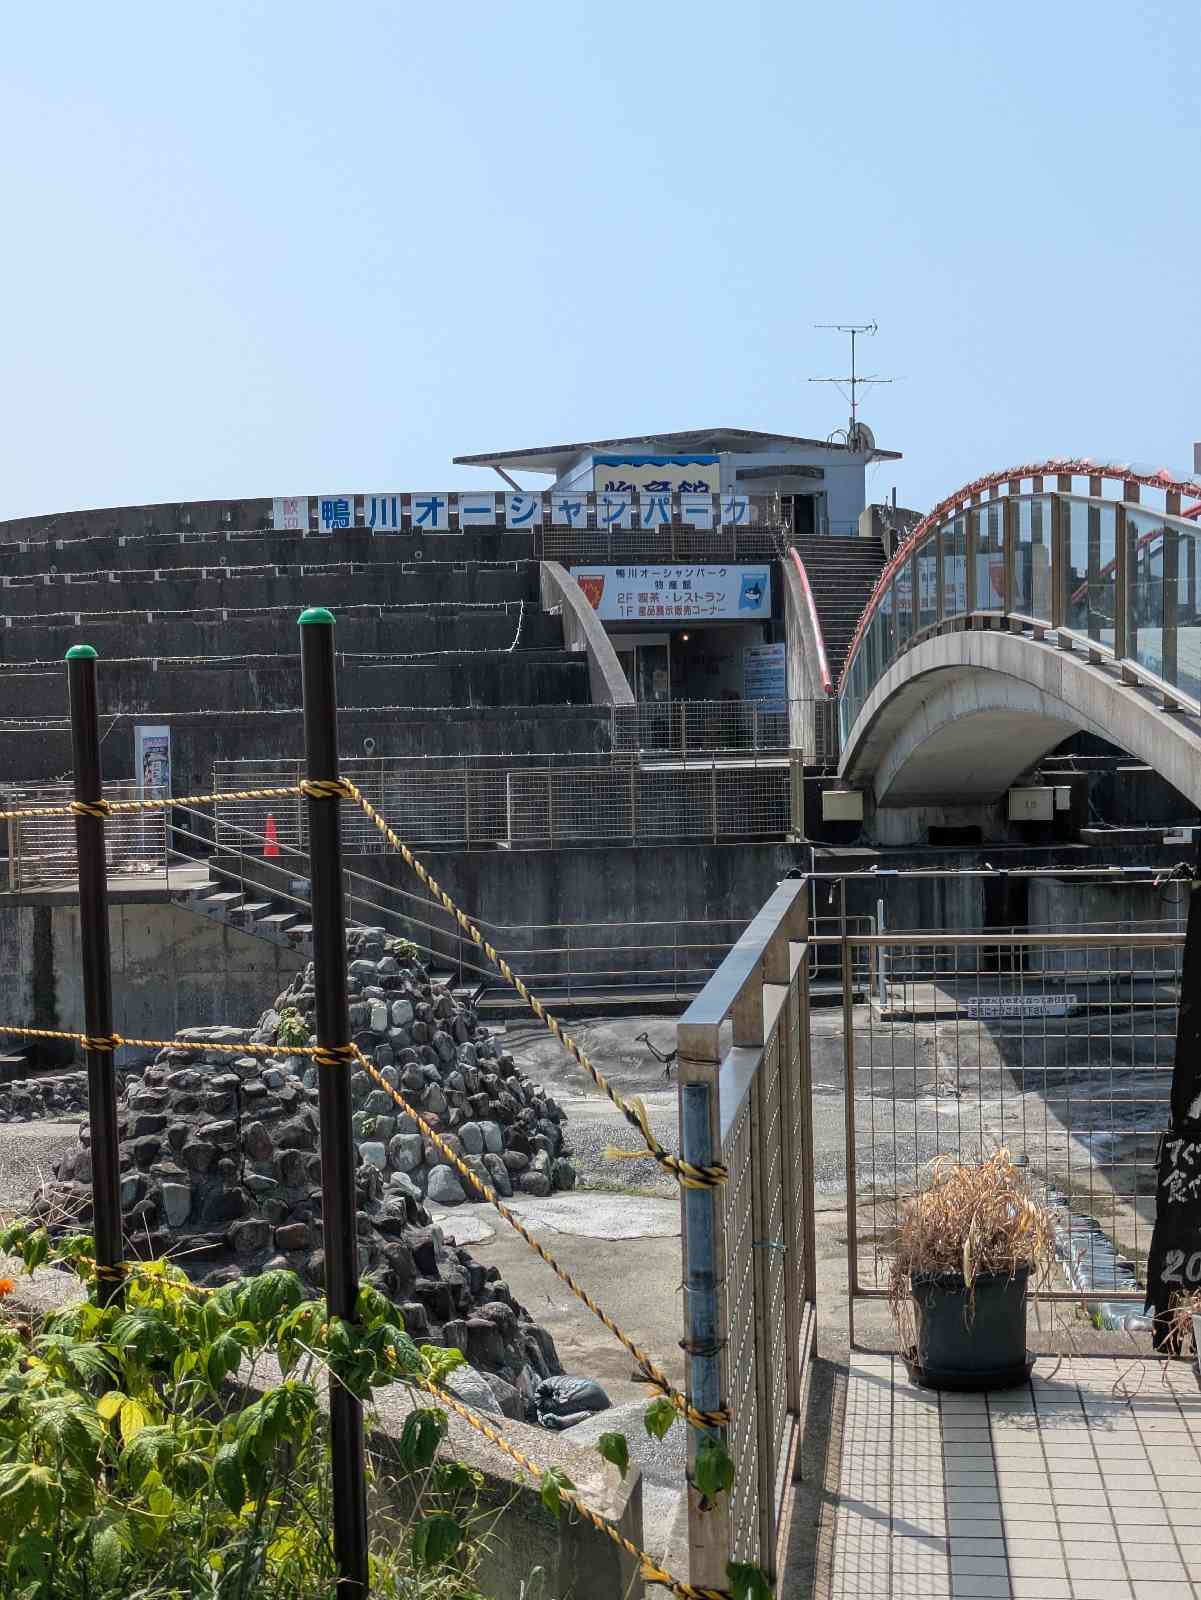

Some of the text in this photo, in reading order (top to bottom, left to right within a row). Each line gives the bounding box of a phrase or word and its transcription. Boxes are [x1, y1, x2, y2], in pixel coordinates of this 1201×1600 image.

[321, 496, 746, 529] 鴨川オーシャンパーク
[615, 568, 728, 578] 鴨川オーシャンパーク
[654, 580, 693, 590] 物産館
[617, 592, 632, 604] 2F
[618, 606, 633, 617] 1F
